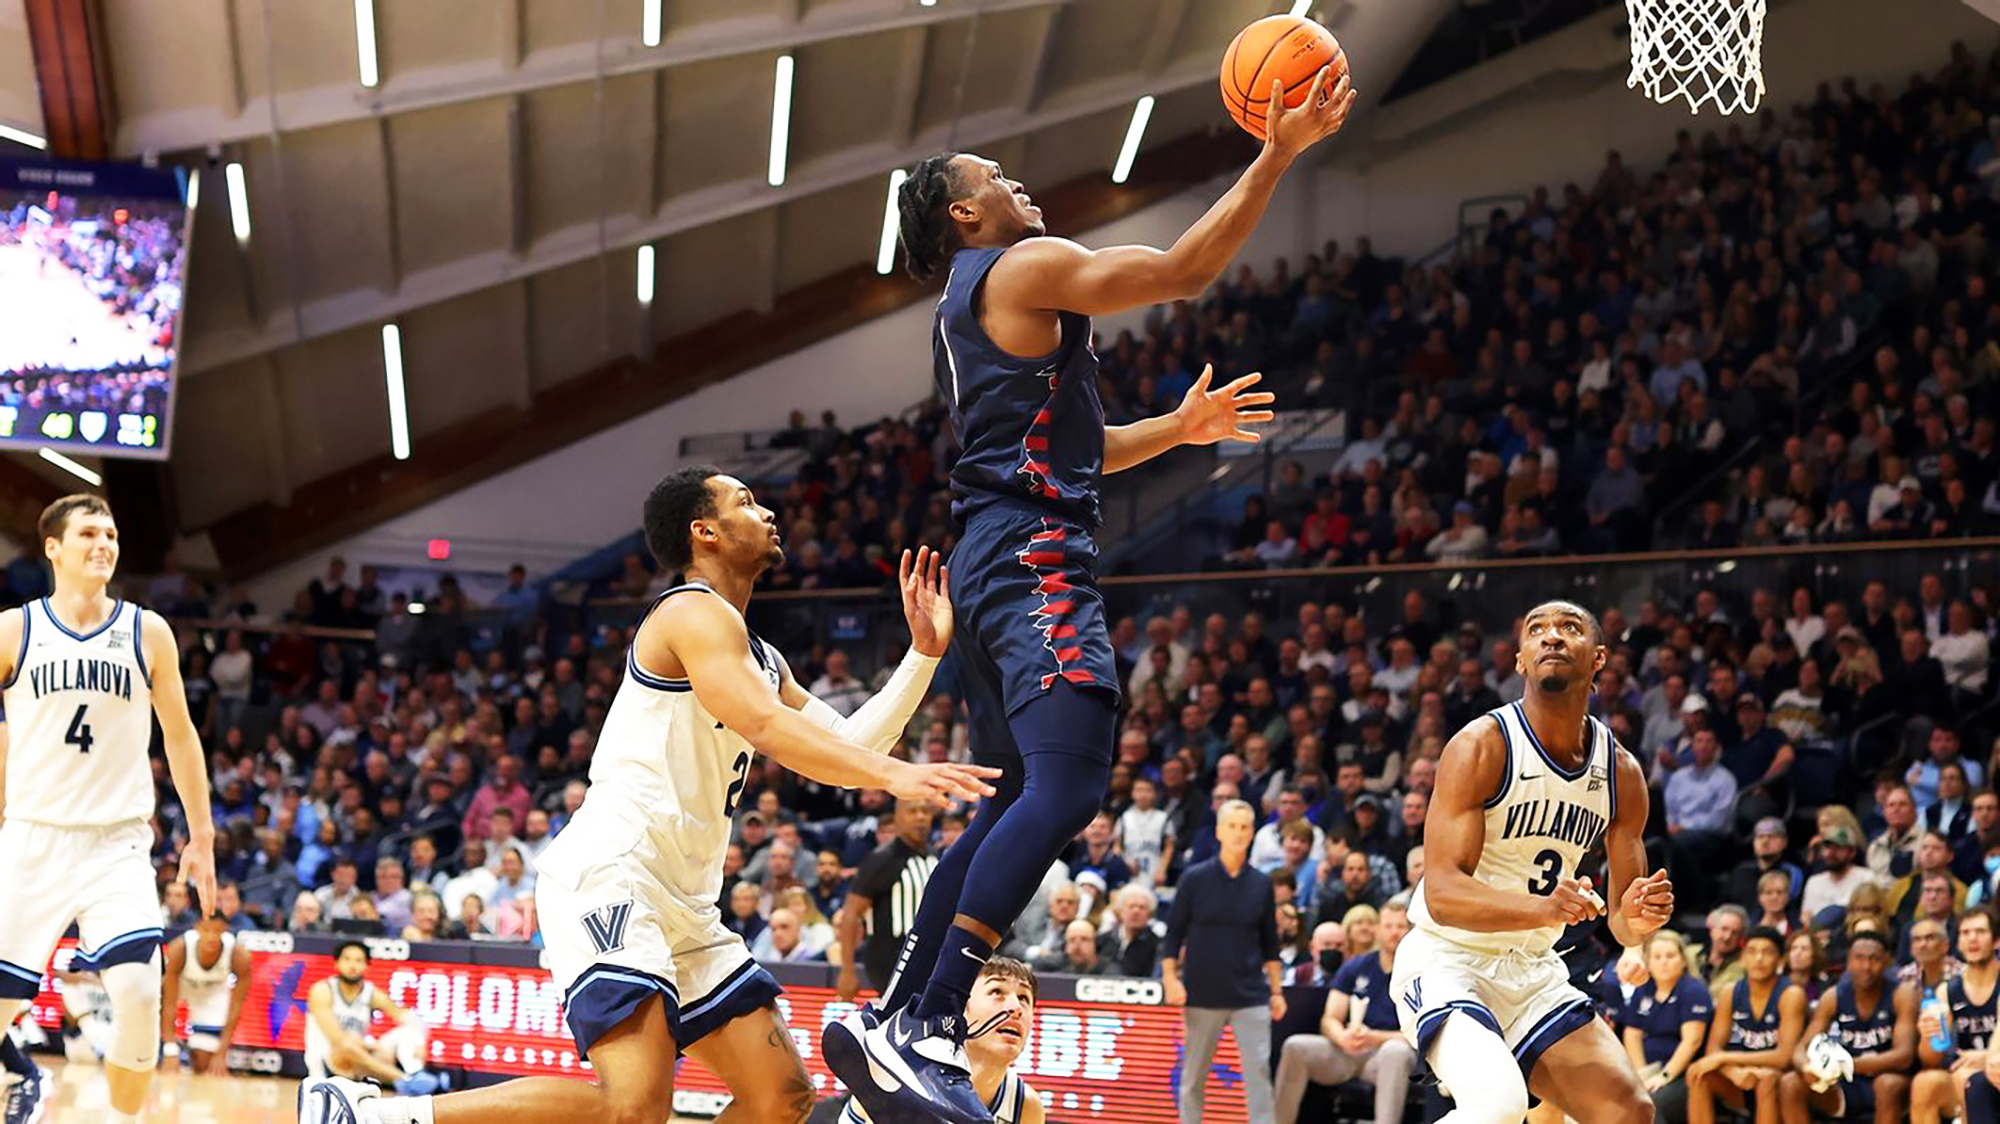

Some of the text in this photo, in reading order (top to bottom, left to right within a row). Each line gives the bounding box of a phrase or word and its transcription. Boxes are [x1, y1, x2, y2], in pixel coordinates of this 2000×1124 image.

[30, 658, 131, 702] VILLANOVA
[65, 704, 94, 753] 4
[581, 900, 634, 956] V
[389, 969, 574, 1040] COLOM
[1076, 978, 1163, 1004] GEICO
[1957, 1015, 1997, 1034] PEN
